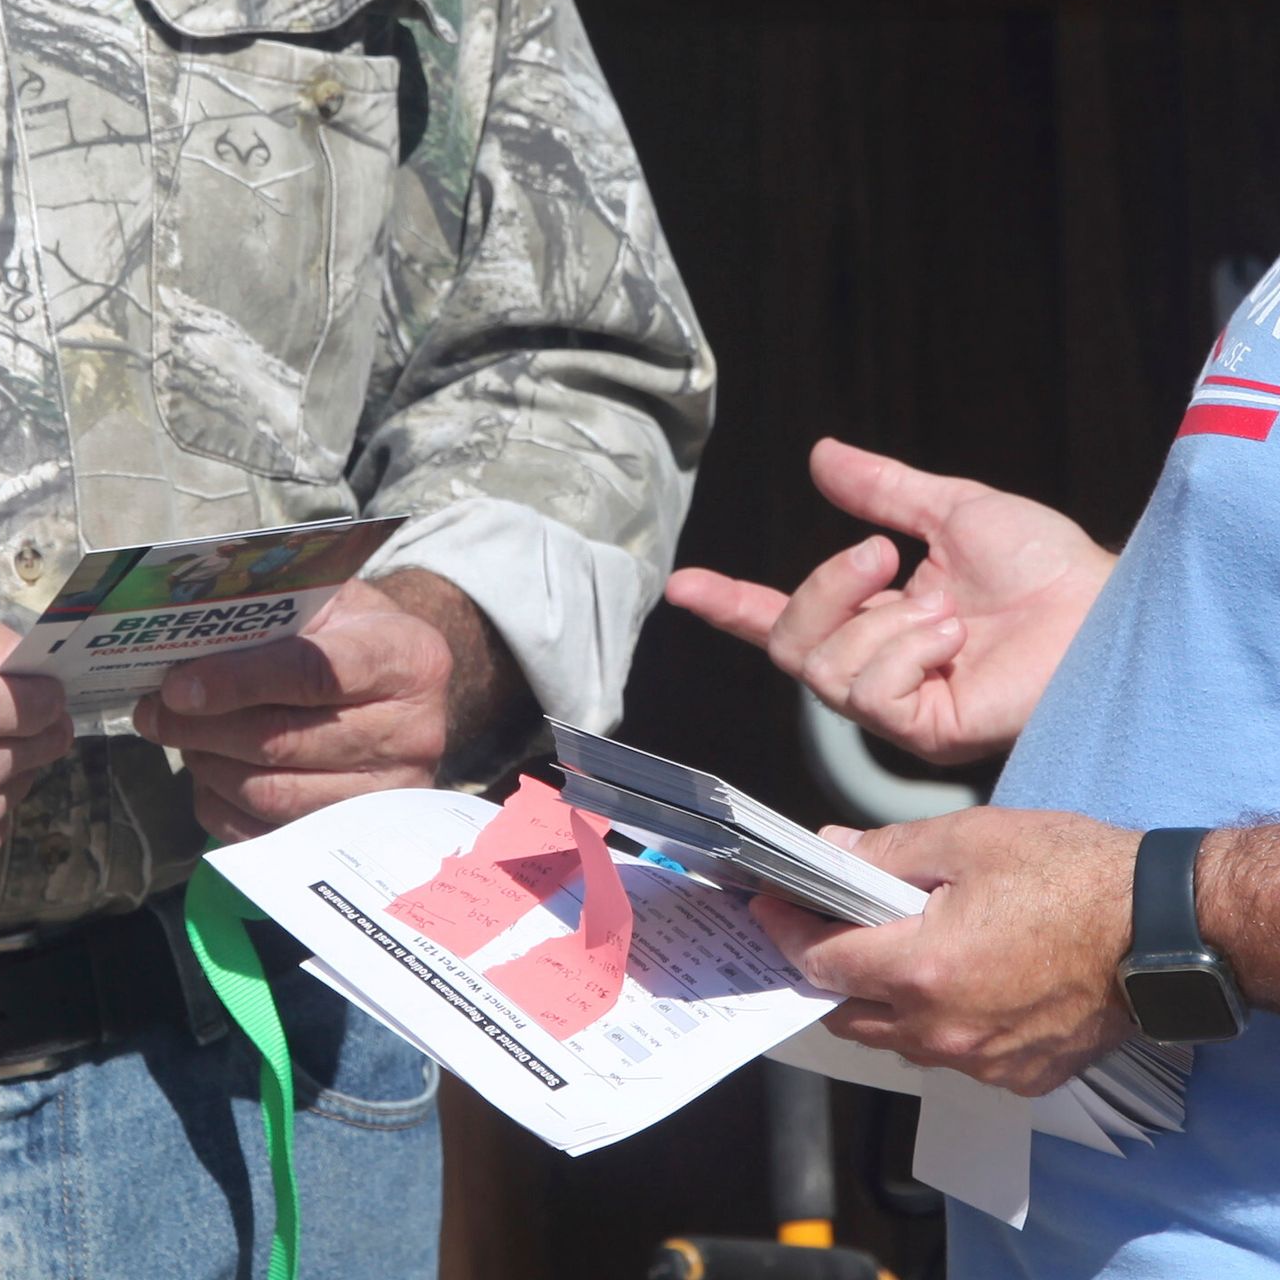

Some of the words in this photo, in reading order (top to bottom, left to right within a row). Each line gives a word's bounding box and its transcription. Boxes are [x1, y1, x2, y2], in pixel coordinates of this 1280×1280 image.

[112, 598, 295, 633] BRENDA
[85, 611, 298, 649] DIETRICH
[90, 646, 127, 657] FOR
[131, 639, 199, 654] KANSAS
[200, 630, 269, 646] SENATE
[318, 886, 359, 920] Primaries
[358, 918, 377, 935] Two
[374, 933, 397, 950] Last
[414, 938, 438, 956] 1211
[404, 955, 432, 978] Voting
[438, 957, 457, 971] Pct
[455, 972, 482, 992] Ward
[432, 980, 485, 1022] Republicans
[484, 993, 526, 1029] Precinct:
[659, 1005, 672, 1013] HP
[485, 1025, 501, 1036] 20
[612, 1034, 624, 1042] HP
[497, 1035, 531, 1062] District
[529, 1061, 560, 1086] Senate
